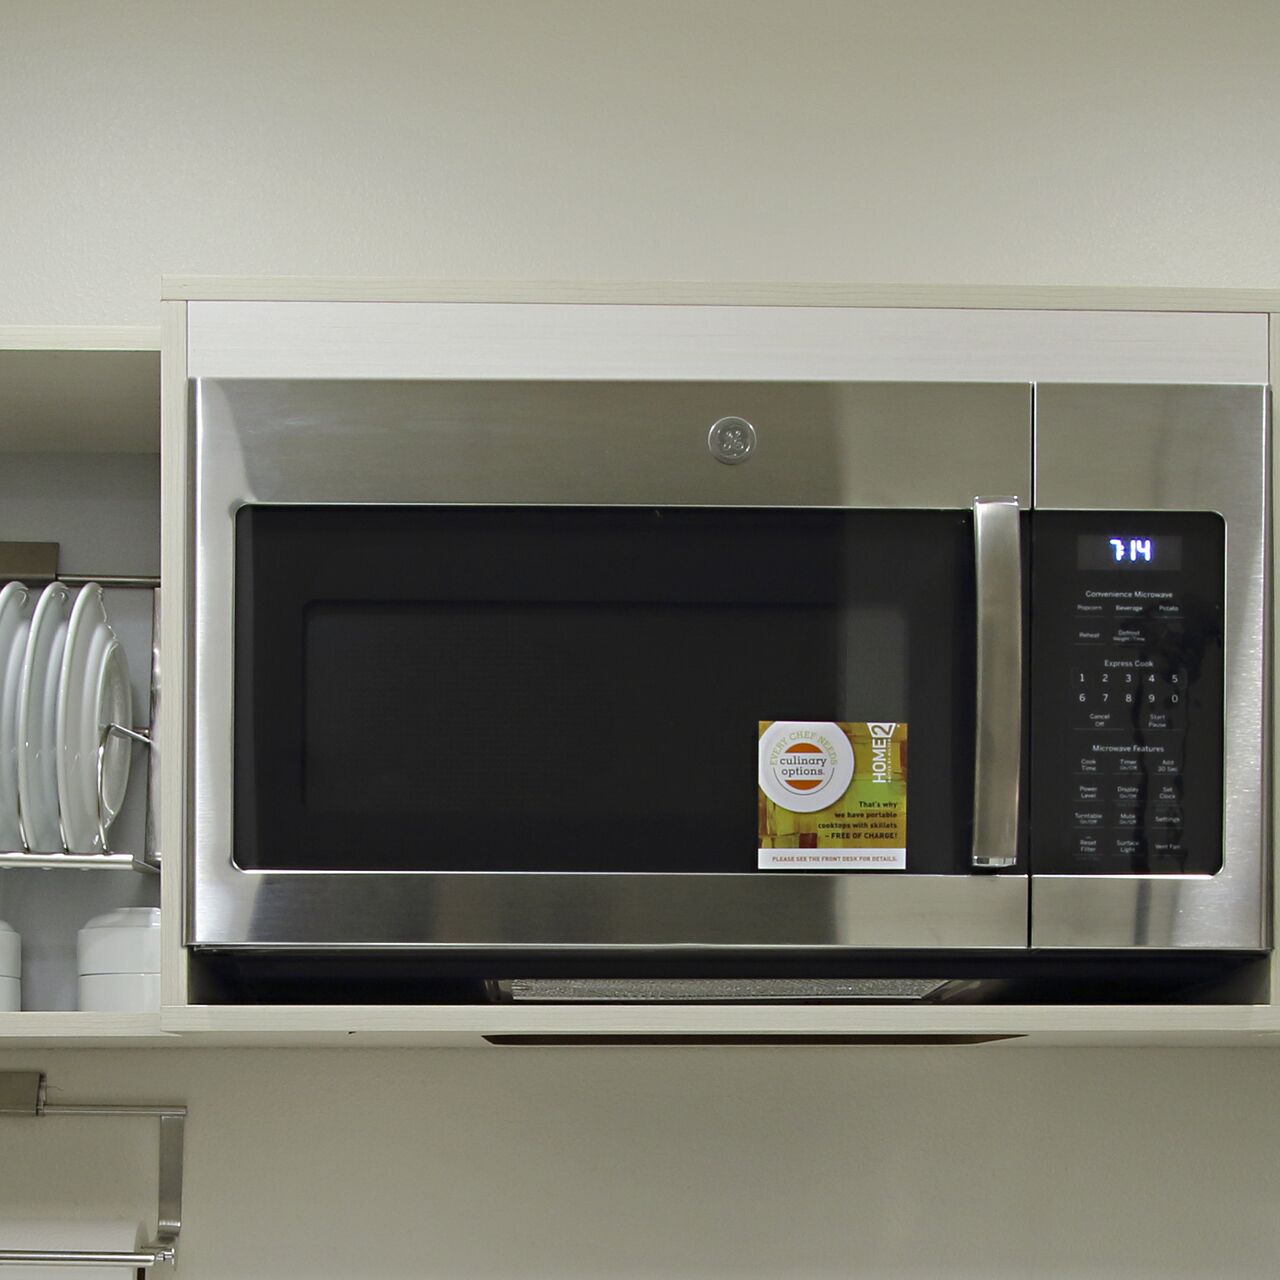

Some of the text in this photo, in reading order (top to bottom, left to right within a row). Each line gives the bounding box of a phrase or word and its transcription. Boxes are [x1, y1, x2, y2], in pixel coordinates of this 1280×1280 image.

[1110, 538, 1152, 562] 7:14
[1085, 590, 1173, 599] Convenience Microwave
[1115, 604, 1143, 612] Beverage
[1104, 660, 1153, 669] Express Cook
[1102, 673, 1109, 682] 2
[1125, 674, 1132, 683] 3
[1148, 674, 1155, 683] 4
[1171, 674, 1178, 683] 5
[1079, 693, 1086, 702] 6
[1102, 693, 1109, 702] 7
[1125, 693, 1132, 702] 8
[1148, 694, 1155, 703] 9
[1171, 694, 1179, 703] 0
[1092, 744, 1164, 753] Microwave Features
[871, 724, 894, 783] HOME2
[779, 755, 827, 767] culinary
[859, 800, 897, 809] That's why
[818, 822, 851, 830] cooktops
[864, 832, 897, 840] CHARGE!
